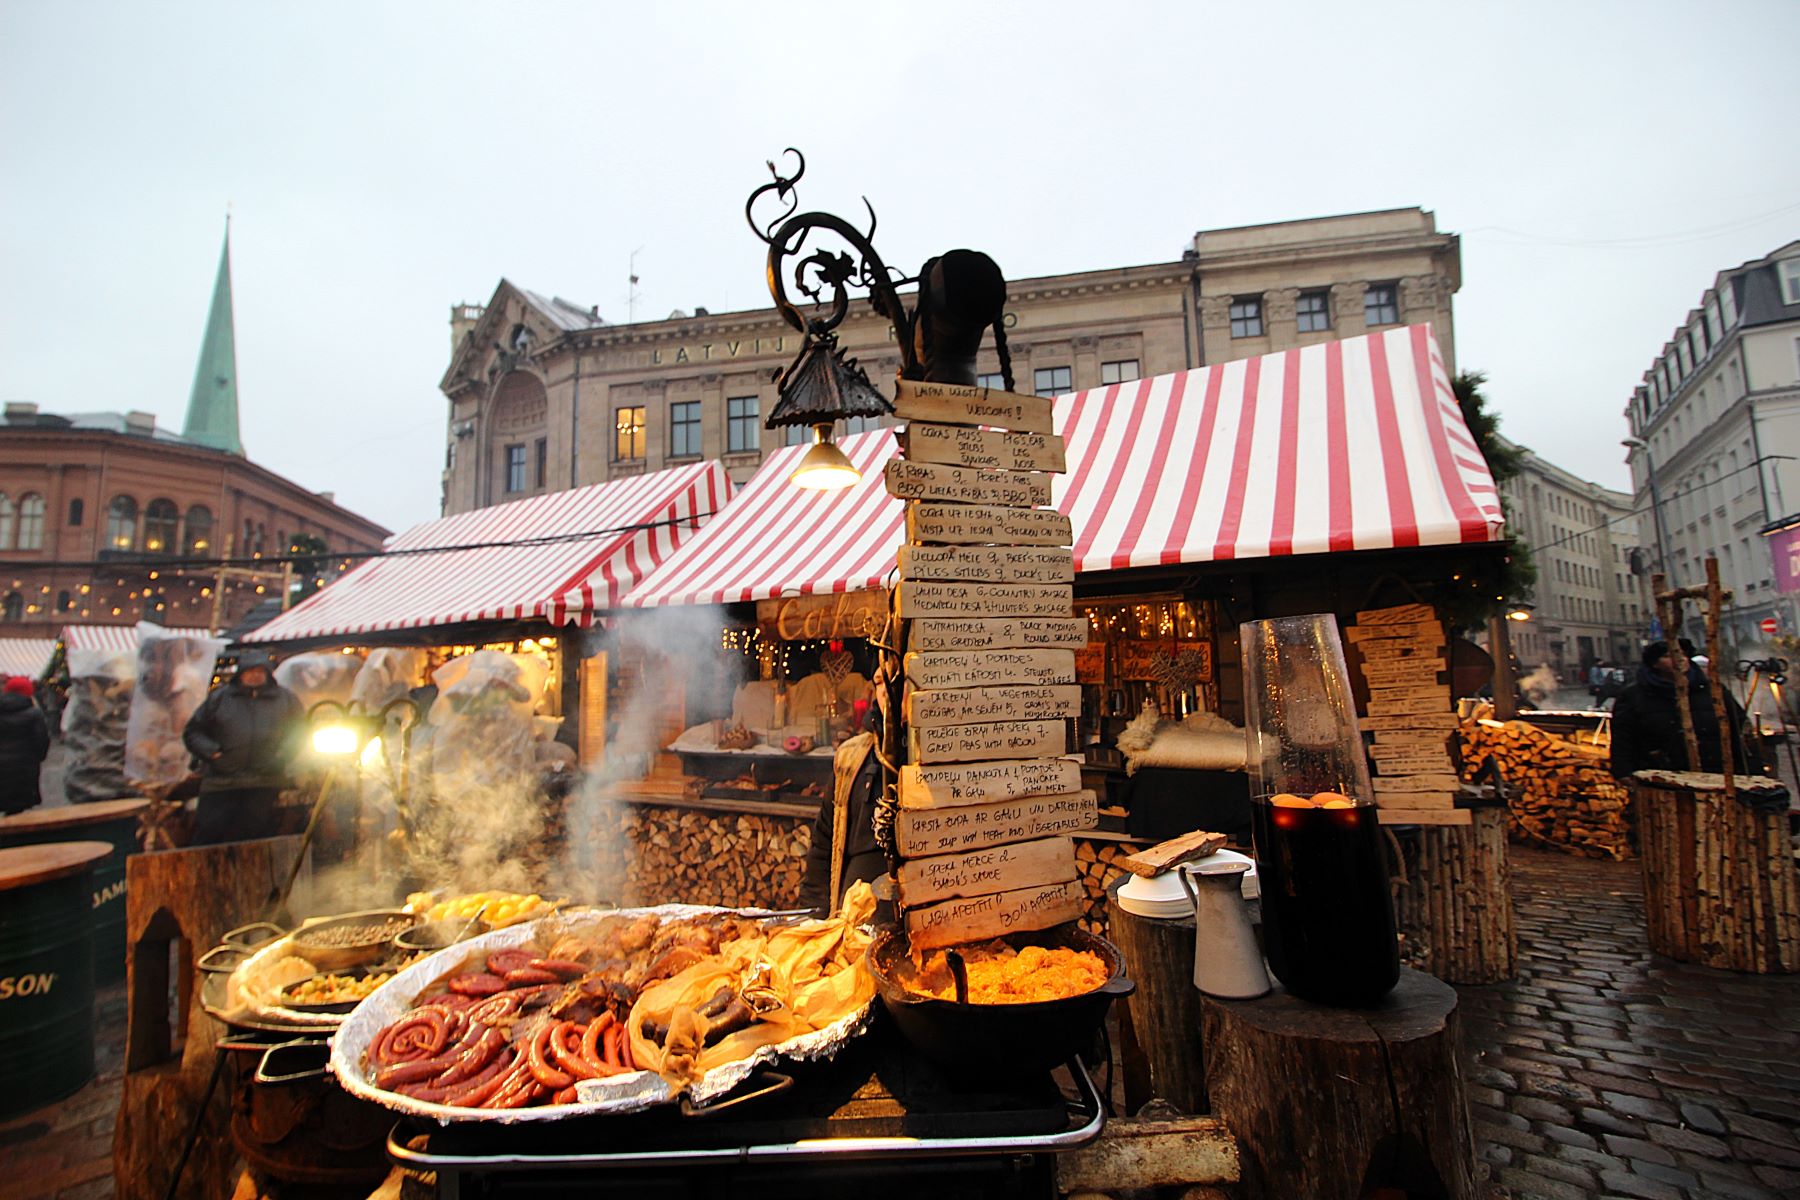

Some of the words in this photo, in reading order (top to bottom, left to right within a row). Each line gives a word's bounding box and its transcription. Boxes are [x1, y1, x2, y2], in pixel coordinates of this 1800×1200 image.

[1013, 458, 1037, 469] NOSE
[898, 482, 925, 498] BBQ
[1003, 489, 1027, 503] BBQ
[1041, 528, 1053, 538] ON
[954, 567, 990, 579] STILBS
[947, 587, 968, 598] DESA
[989, 587, 1035, 598] COUNTRY
[960, 601, 982, 612] DESA
[1033, 603, 1068, 614] SAUSAGE
[922, 637, 946, 648] DESA
[1023, 633, 1050, 644] ROUND
[999, 688, 1055, 700] VEGETABLES
[993, 723, 1004, 733] AR
[960, 739, 981, 751] PEAS
[985, 739, 1002, 749] WITH
[1046, 784, 1067, 793] MEAT
[975, 811, 989, 824] AR
[983, 828, 1006, 841] MEAT
[1028, 818, 1081, 834] VEGETABLES
[92, 879, 127, 910] JAM
[998, 901, 1028, 928] BON
